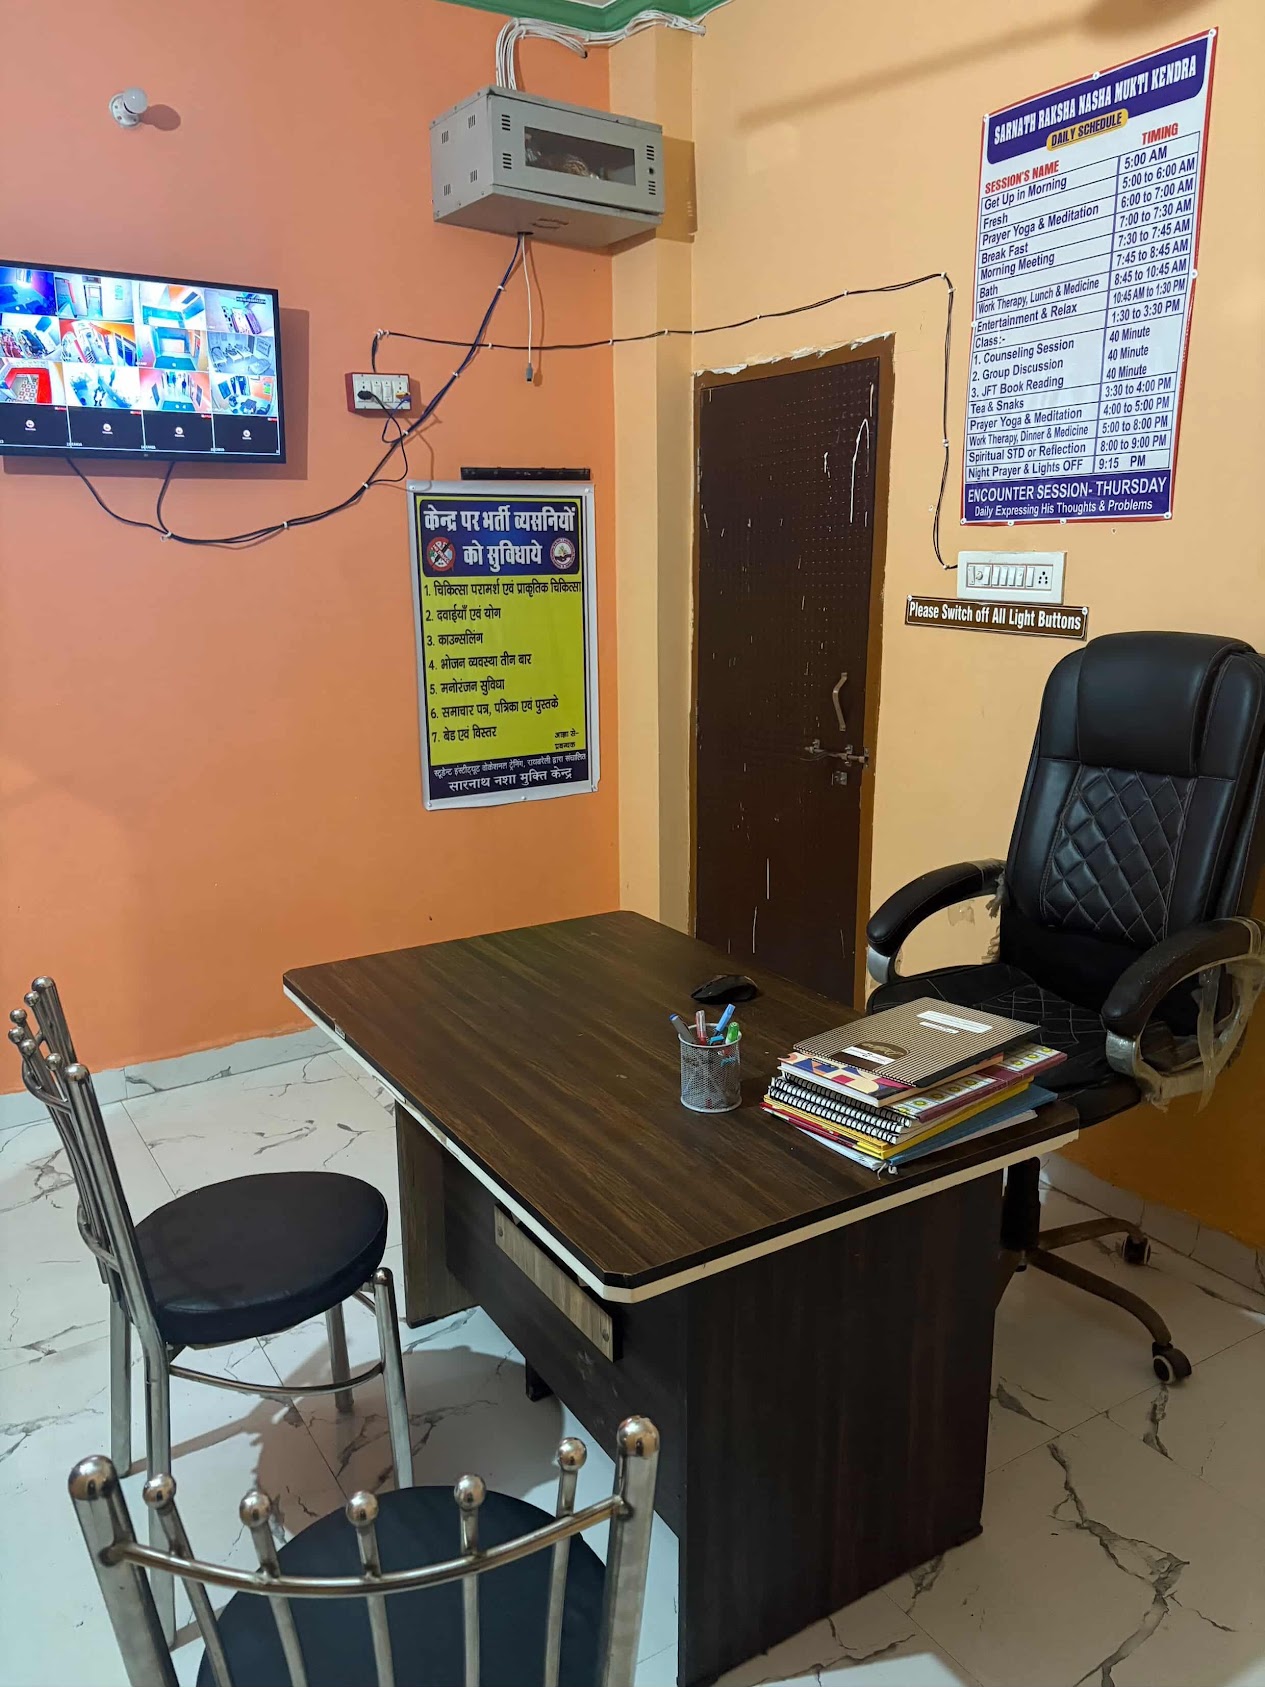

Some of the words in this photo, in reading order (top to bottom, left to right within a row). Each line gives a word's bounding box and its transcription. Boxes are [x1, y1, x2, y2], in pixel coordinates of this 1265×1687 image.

[994, 112, 1036, 145] SARNATH
[1038, 98, 1075, 129] RAKSHA
[1079, 86, 1111, 115] NASHA
[1114, 72, 1149, 103] MUKTI
[1151, 55, 1196, 90] KENDRA
[1052, 127, 1076, 146] DAILY
[1078, 112, 1122, 137] SCHEDULE
[1142, 123, 1178, 145] TIMING
[1124, 152, 1146, 169] 5:00
[1149, 146, 1167, 163] AM
[985, 170, 1030, 194] SESSION'S
[1032, 160, 1059, 179] NAME
[1123, 173, 1141, 189] 5:00
[1145, 171, 1153, 183] to
[1157, 163, 1176, 179] 6:00
[1179, 157, 1195, 173] AM
[985, 196, 999, 210] Get
[1002, 193, 1014, 206] Up
[1017, 189, 1025, 200] in
[1028, 177, 1067, 196] Morning
[1121, 193, 1140, 208] 6:00
[1143, 192, 1152, 202] to
[1155, 183, 1175, 199] 7:00
[1177, 178, 1193, 194] AM
[983, 213, 1008, 229] Fresh
[983, 229, 1011, 245] Prayer
[1013, 221, 1035, 236] Yoga
[1038, 218, 1044, 229] &
[1048, 205, 1099, 227] Meditation
[981, 248, 1006, 264] Break
[1009, 242, 1028, 256] Fast
[1117, 251, 1135, 267] 7:45
[1138, 250, 1147, 261] to
[1150, 243, 1170, 258] 8:45
[1172, 238, 1188, 253] AM
[981, 264, 1015, 280] Morning
[1019, 253, 1055, 270] Meeting
[980, 284, 998, 298] Bath
[977, 310, 1038, 332] Entertainment
[1041, 308, 1047, 319] &
[1051, 303, 1077, 317] Relax
[1112, 309, 1129, 323] 1:30
[1133, 308, 1141, 319] to
[1144, 302, 1162, 317] 3:30
[1165, 298, 1180, 313] PM
[1109, 331, 1119, 343] 40
[1122, 326, 1150, 341] Minute
[974, 355, 981, 365] 1.
[984, 346, 1034, 363] Counseling
[1037, 339, 1074, 354] Session
[972, 371, 979, 381] 2.
[983, 368, 1010, 379] Group
[1013, 359, 1063, 375] Discussion
[1107, 368, 1116, 379] 40
[1118, 364, 1147, 378] Minute
[972, 388, 978, 398] 3.
[982, 384, 997, 396] JFT
[1000, 381, 1023, 394] Book
[1026, 376, 1064, 390] Reading
[1105, 383, 1123, 398] 3:30
[1125, 383, 1134, 394] to
[1137, 380, 1155, 393] 4:00
[1158, 377, 1171, 390] PM
[971, 403, 985, 414] Tea
[988, 401, 993, 411] &
[997, 398, 1024, 410] Snaks
[970, 420, 997, 431] Prayer
[1000, 416, 1021, 428] Yoga
[1025, 414, 1031, 424] &
[1035, 408, 1082, 423] Meditation
[969, 436, 986, 446] Work
[988, 433, 1018, 445] Therapy,
[1021, 430, 1044, 441] Dinner
[1047, 428, 1051, 438] &
[1054, 425, 1088, 438] Medicine
[969, 450, 1004, 463] Spiritual
[1007, 448, 1024, 459] STD
[1028, 448, 1036, 457] or
[1040, 443, 1085, 456] Reflection
[1099, 457, 1119, 470] 9:15
[1130, 455, 1146, 467] PM
[969, 468, 989, 479] Night
[992, 466, 1021, 478] Prayer
[1024, 464, 1029, 474] &
[1033, 461, 1060, 475] Lights
[1063, 459, 1083, 471] OFF
[968, 486, 1033, 503] ENCOUNTER
[1037, 482, 1092, 499] SESSION-
[1096, 477, 1167, 495] THURSDAY
[423, 504, 457, 532] केन्द्र
[460, 511, 480, 532] पर
[483, 505, 510, 532] भर्ती
[514, 506, 575, 532] व्यसनियों
[975, 506, 993, 516] Daily
[996, 504, 1039, 516] Expressing
[1041, 503, 1054, 513] His
[1057, 502, 1096, 513] Thoughts
[1099, 500, 1105, 511] &
[1108, 498, 1152, 511] Problems
[462, 539, 484, 565] को
[909, 602, 939, 619] Please
[942, 604, 972, 622] Switch
[976, 608, 989, 622] off
[992, 608, 1005, 624] All
[1009, 609, 1035, 628] Light
[1038, 612, 1081, 630] Buttons
[449, 778, 490, 791] सारनाथ
[494, 774, 516, 785] नशा
[520, 769, 547, 785] मुक्ति
[551, 766, 572, 779] केन्द्र
